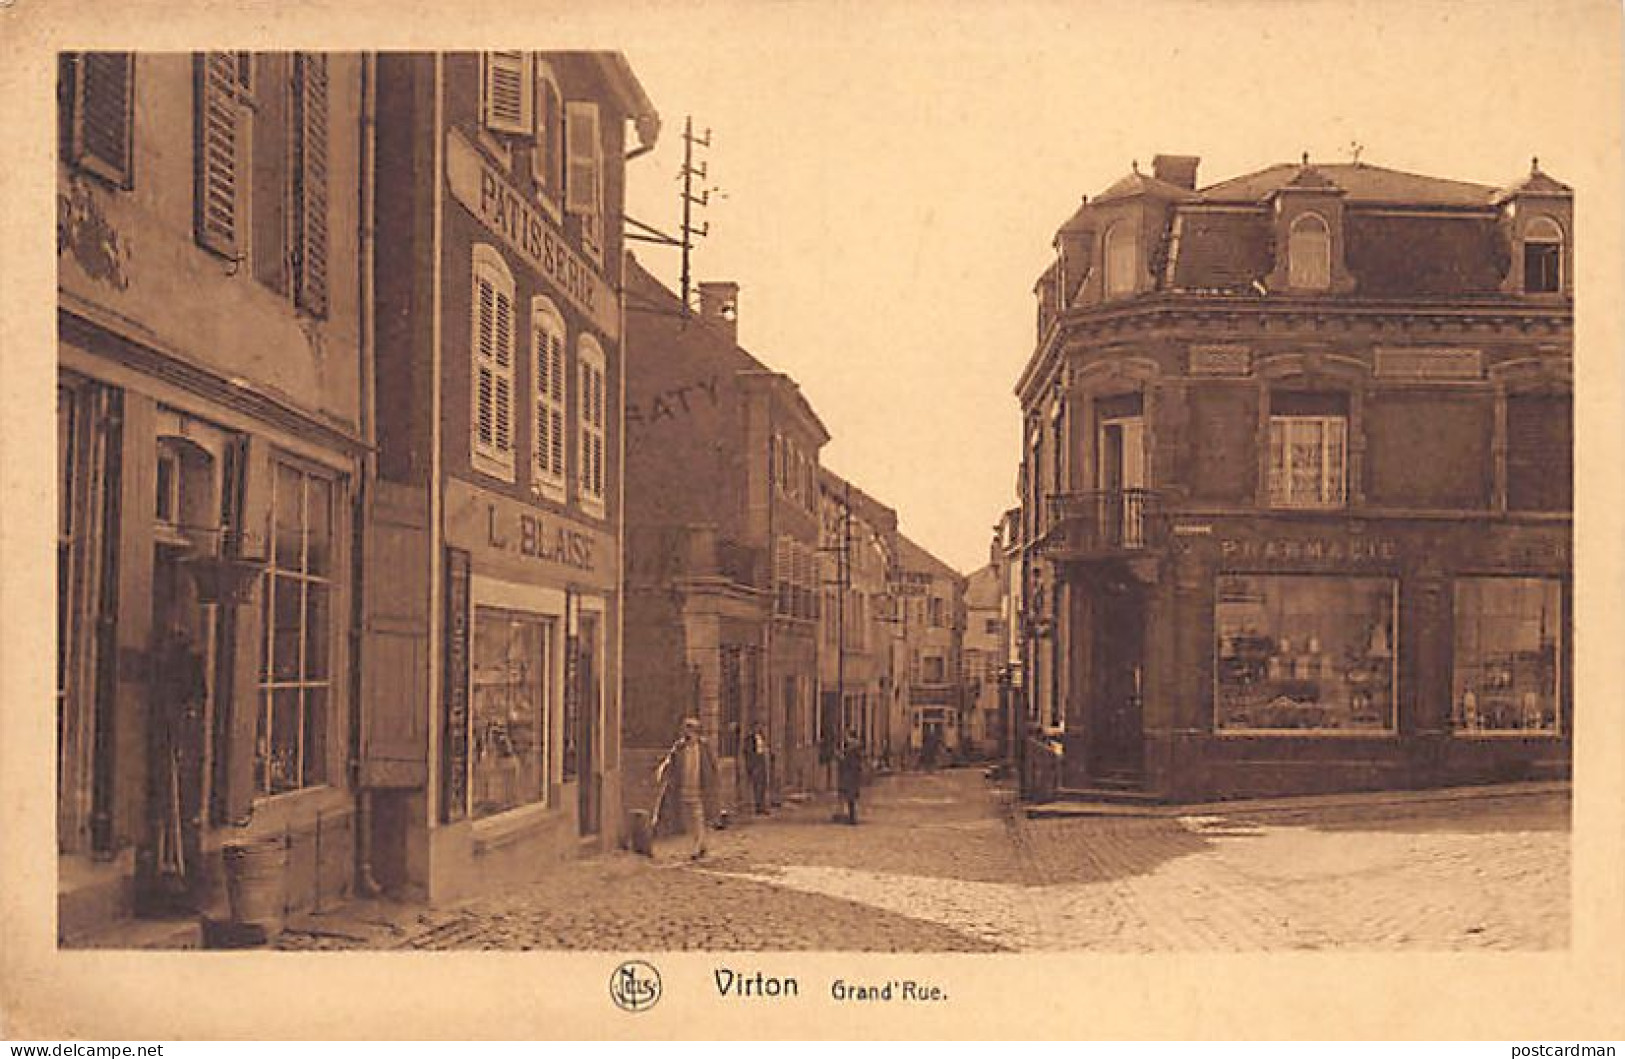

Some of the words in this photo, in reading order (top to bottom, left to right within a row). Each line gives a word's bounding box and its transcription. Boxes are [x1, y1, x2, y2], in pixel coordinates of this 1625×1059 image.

[481, 166, 595, 312] PATISSERIE
[520, 514, 595, 571] BLAISE
[1221, 539, 1398, 560] PHARMACIE
